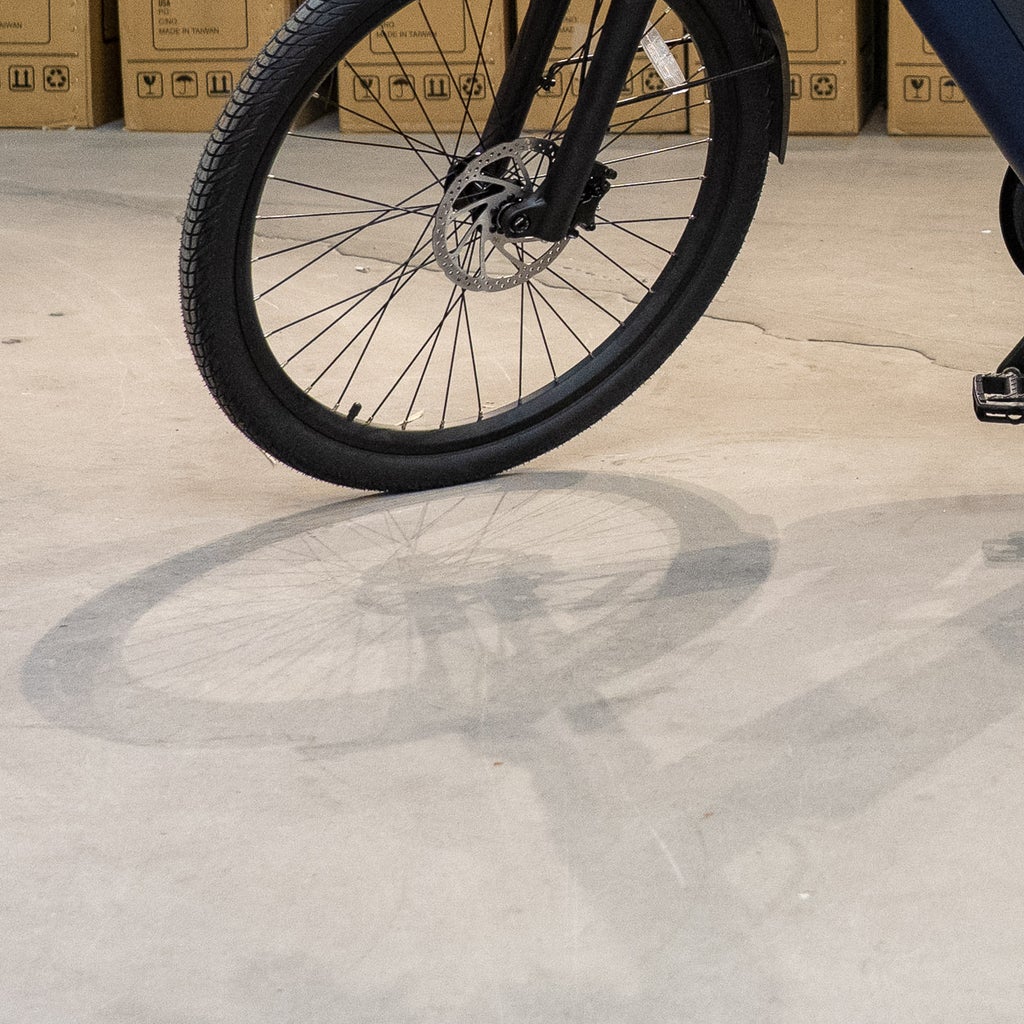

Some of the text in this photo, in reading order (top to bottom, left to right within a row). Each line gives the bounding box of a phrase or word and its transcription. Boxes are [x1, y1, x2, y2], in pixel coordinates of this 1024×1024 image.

[158, 0, 170, 8] USA
[158, 27, 220, 36] MADE IN TAIWAN
